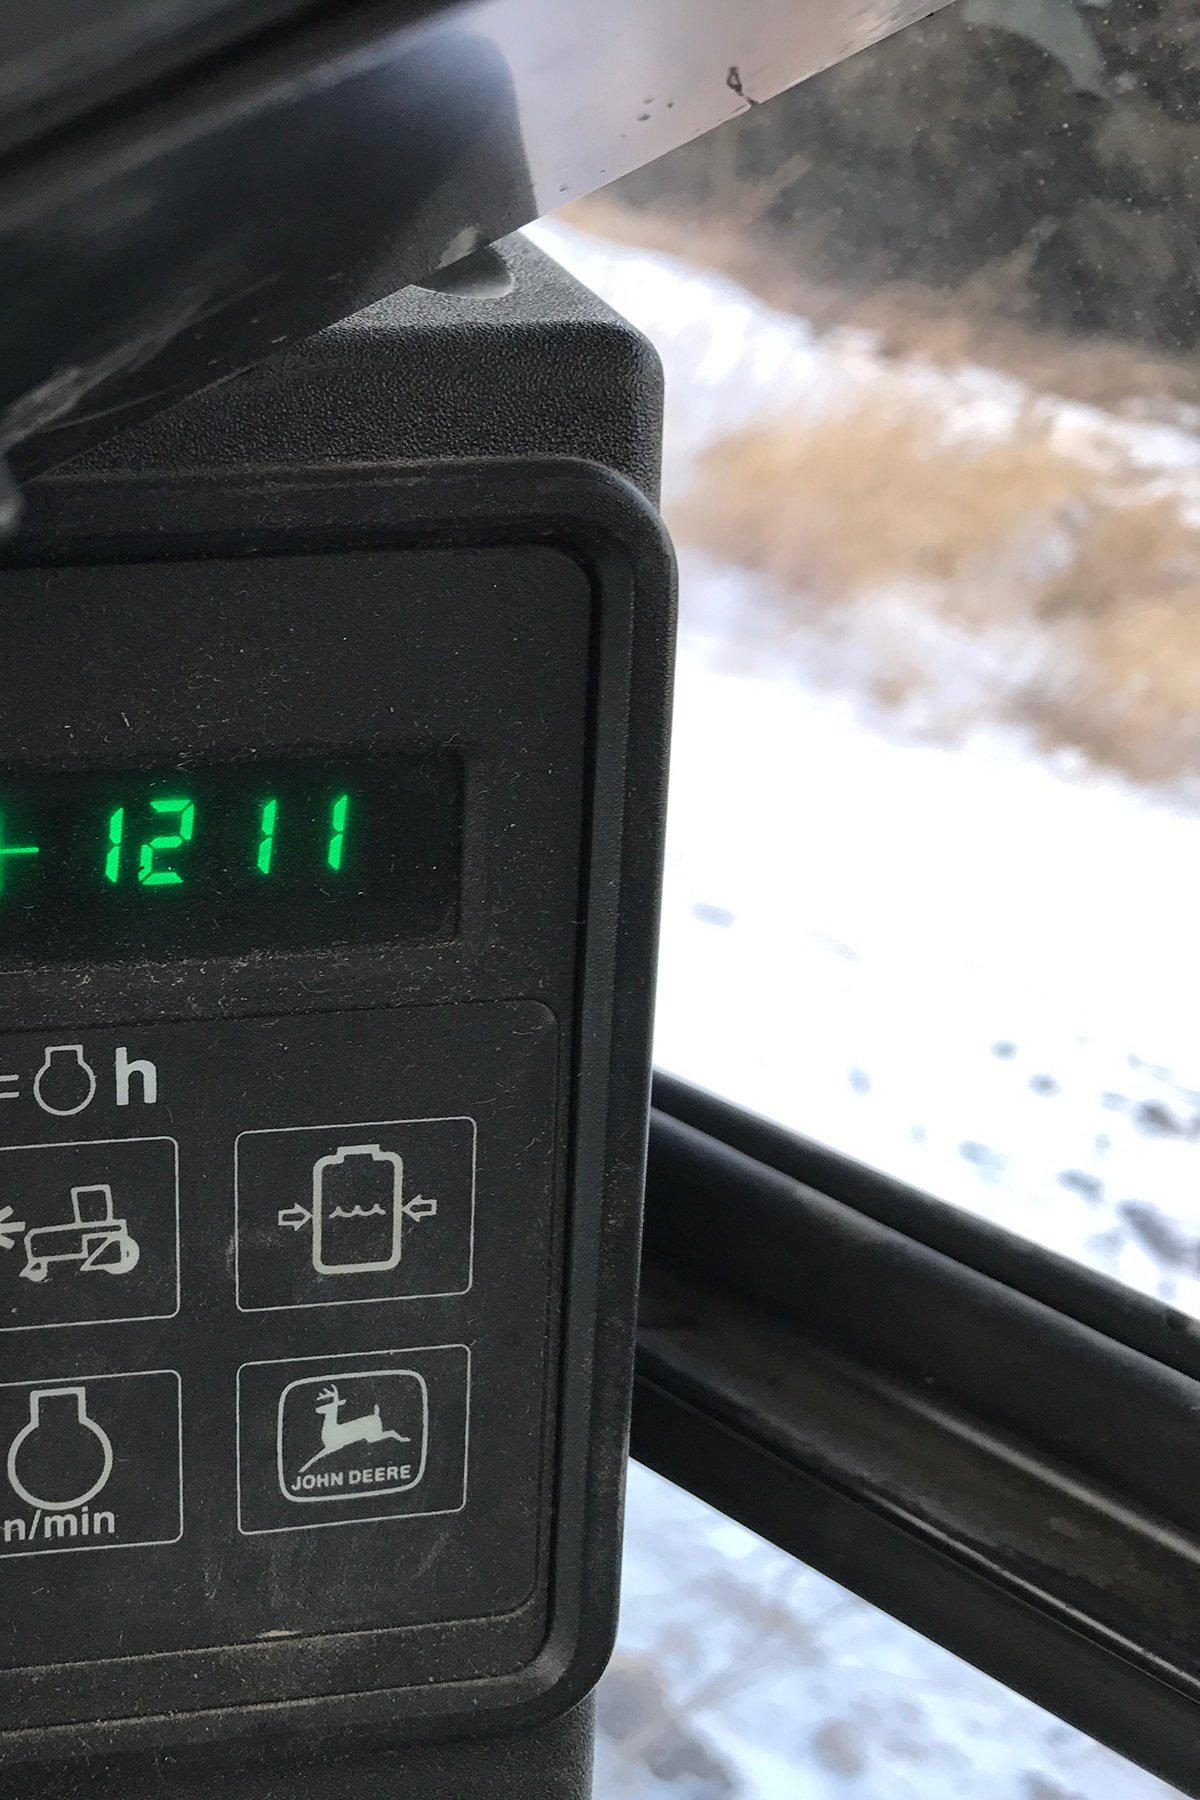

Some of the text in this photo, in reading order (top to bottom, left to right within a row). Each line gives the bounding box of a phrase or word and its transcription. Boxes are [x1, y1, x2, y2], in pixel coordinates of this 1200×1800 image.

[105, 795, 348, 885] 1211
[115, 1046, 157, 1105] h
[291, 1464, 411, 1491] JOHN DEERE
[3, 1506, 115, 1542] n/min
